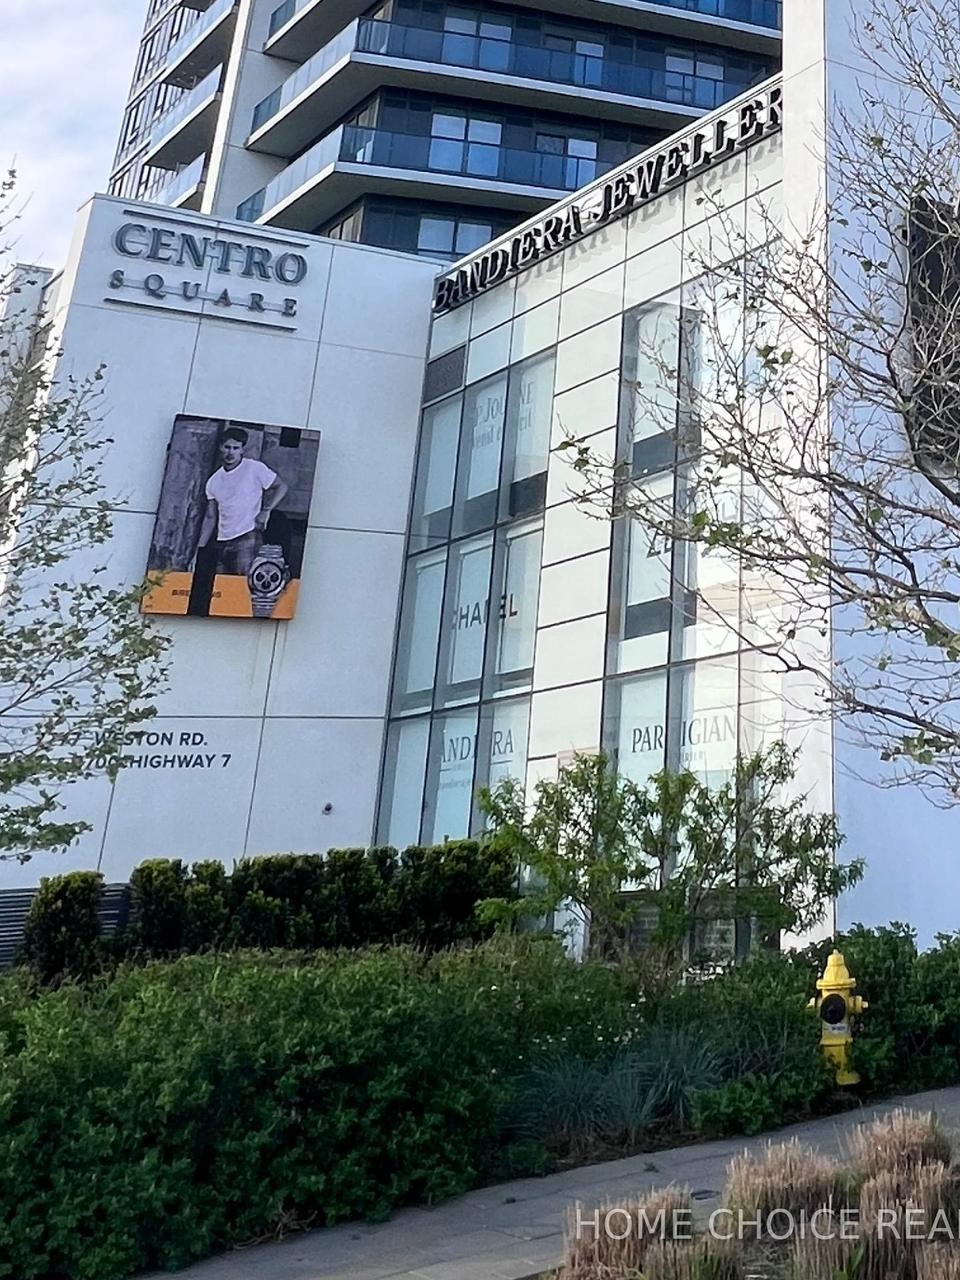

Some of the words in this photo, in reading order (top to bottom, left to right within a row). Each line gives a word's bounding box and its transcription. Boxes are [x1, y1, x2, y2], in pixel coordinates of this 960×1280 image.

[113, 222, 308, 285] CENTRO
[432, 205, 585, 313] BANDIERA
[109, 269, 298, 318] SQUARE
[94, 731, 174, 747] WESTON
[179, 732, 208, 747] RD.
[129, 753, 217, 769] HIGHWAY
[221, 754, 232, 768] 7
